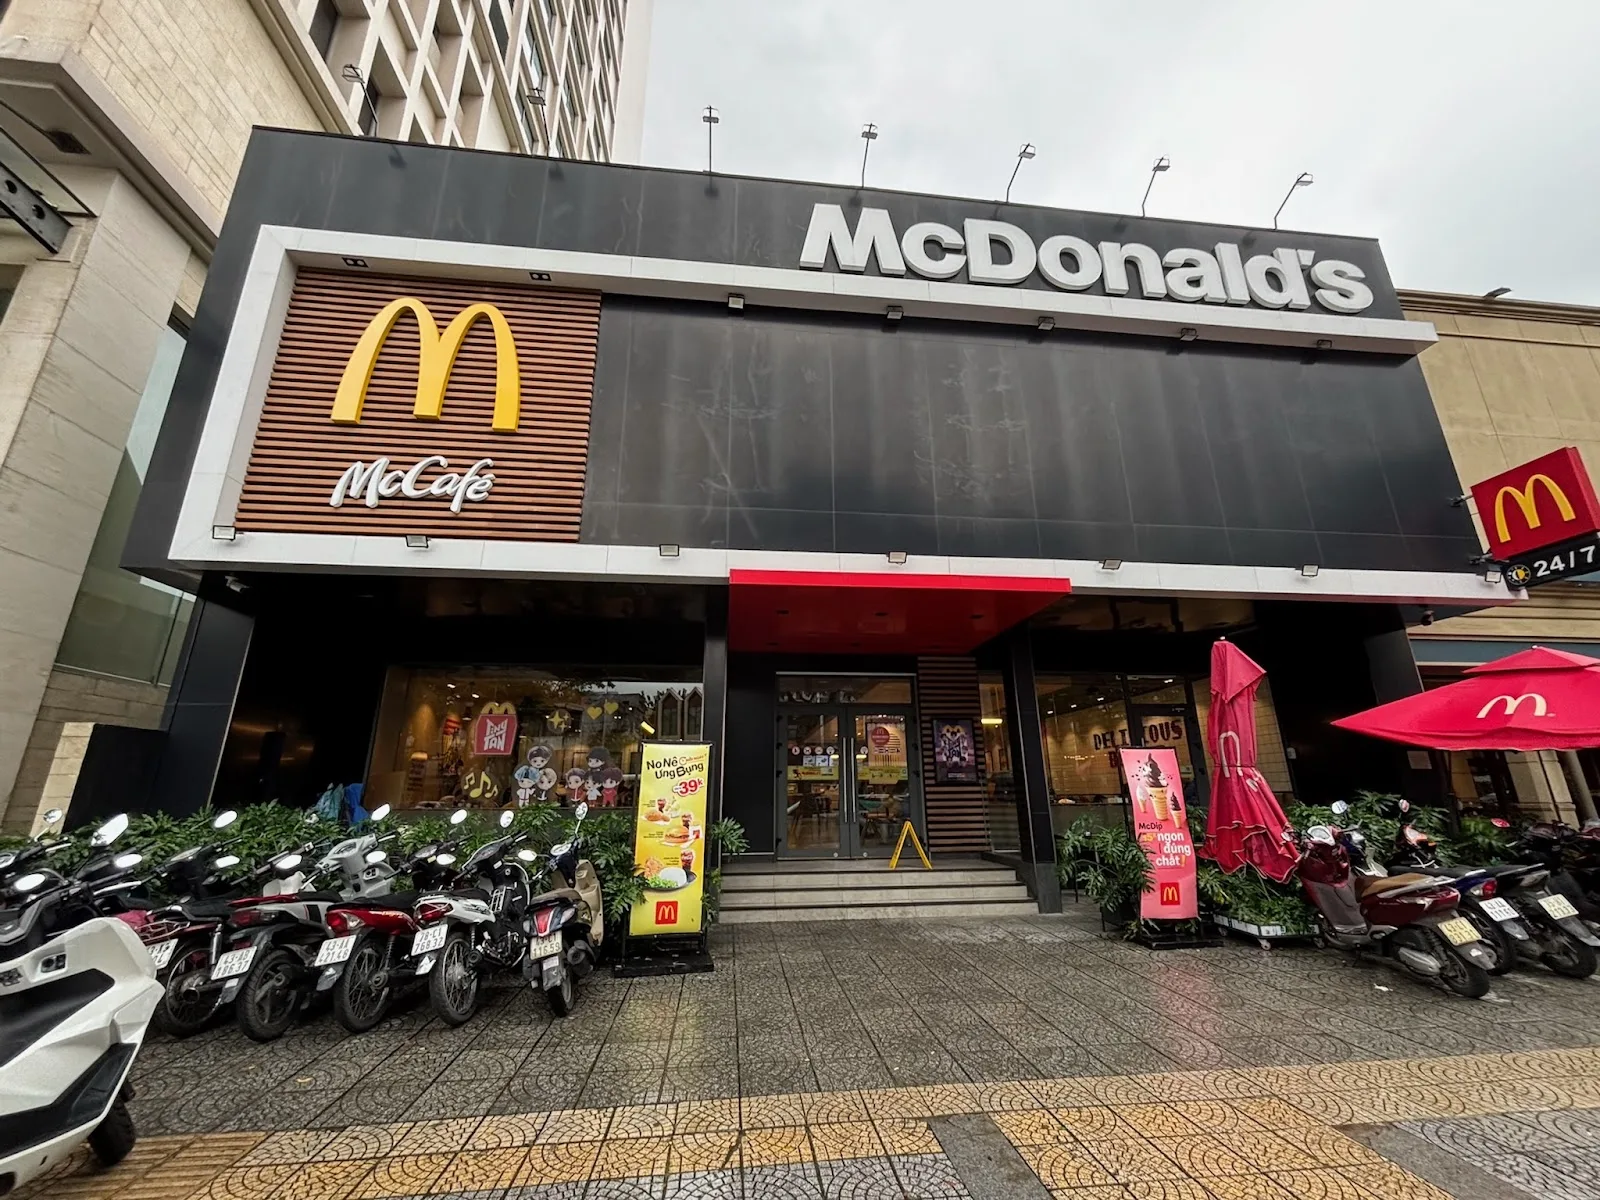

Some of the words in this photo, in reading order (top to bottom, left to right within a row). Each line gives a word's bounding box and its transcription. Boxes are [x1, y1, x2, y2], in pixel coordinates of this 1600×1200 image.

[800, 203, 1373, 313] McDonald's
[329, 455, 496, 514] McCafé
[1138, 822, 1163, 831] McDip
[1157, 832, 1184, 843] ngon
